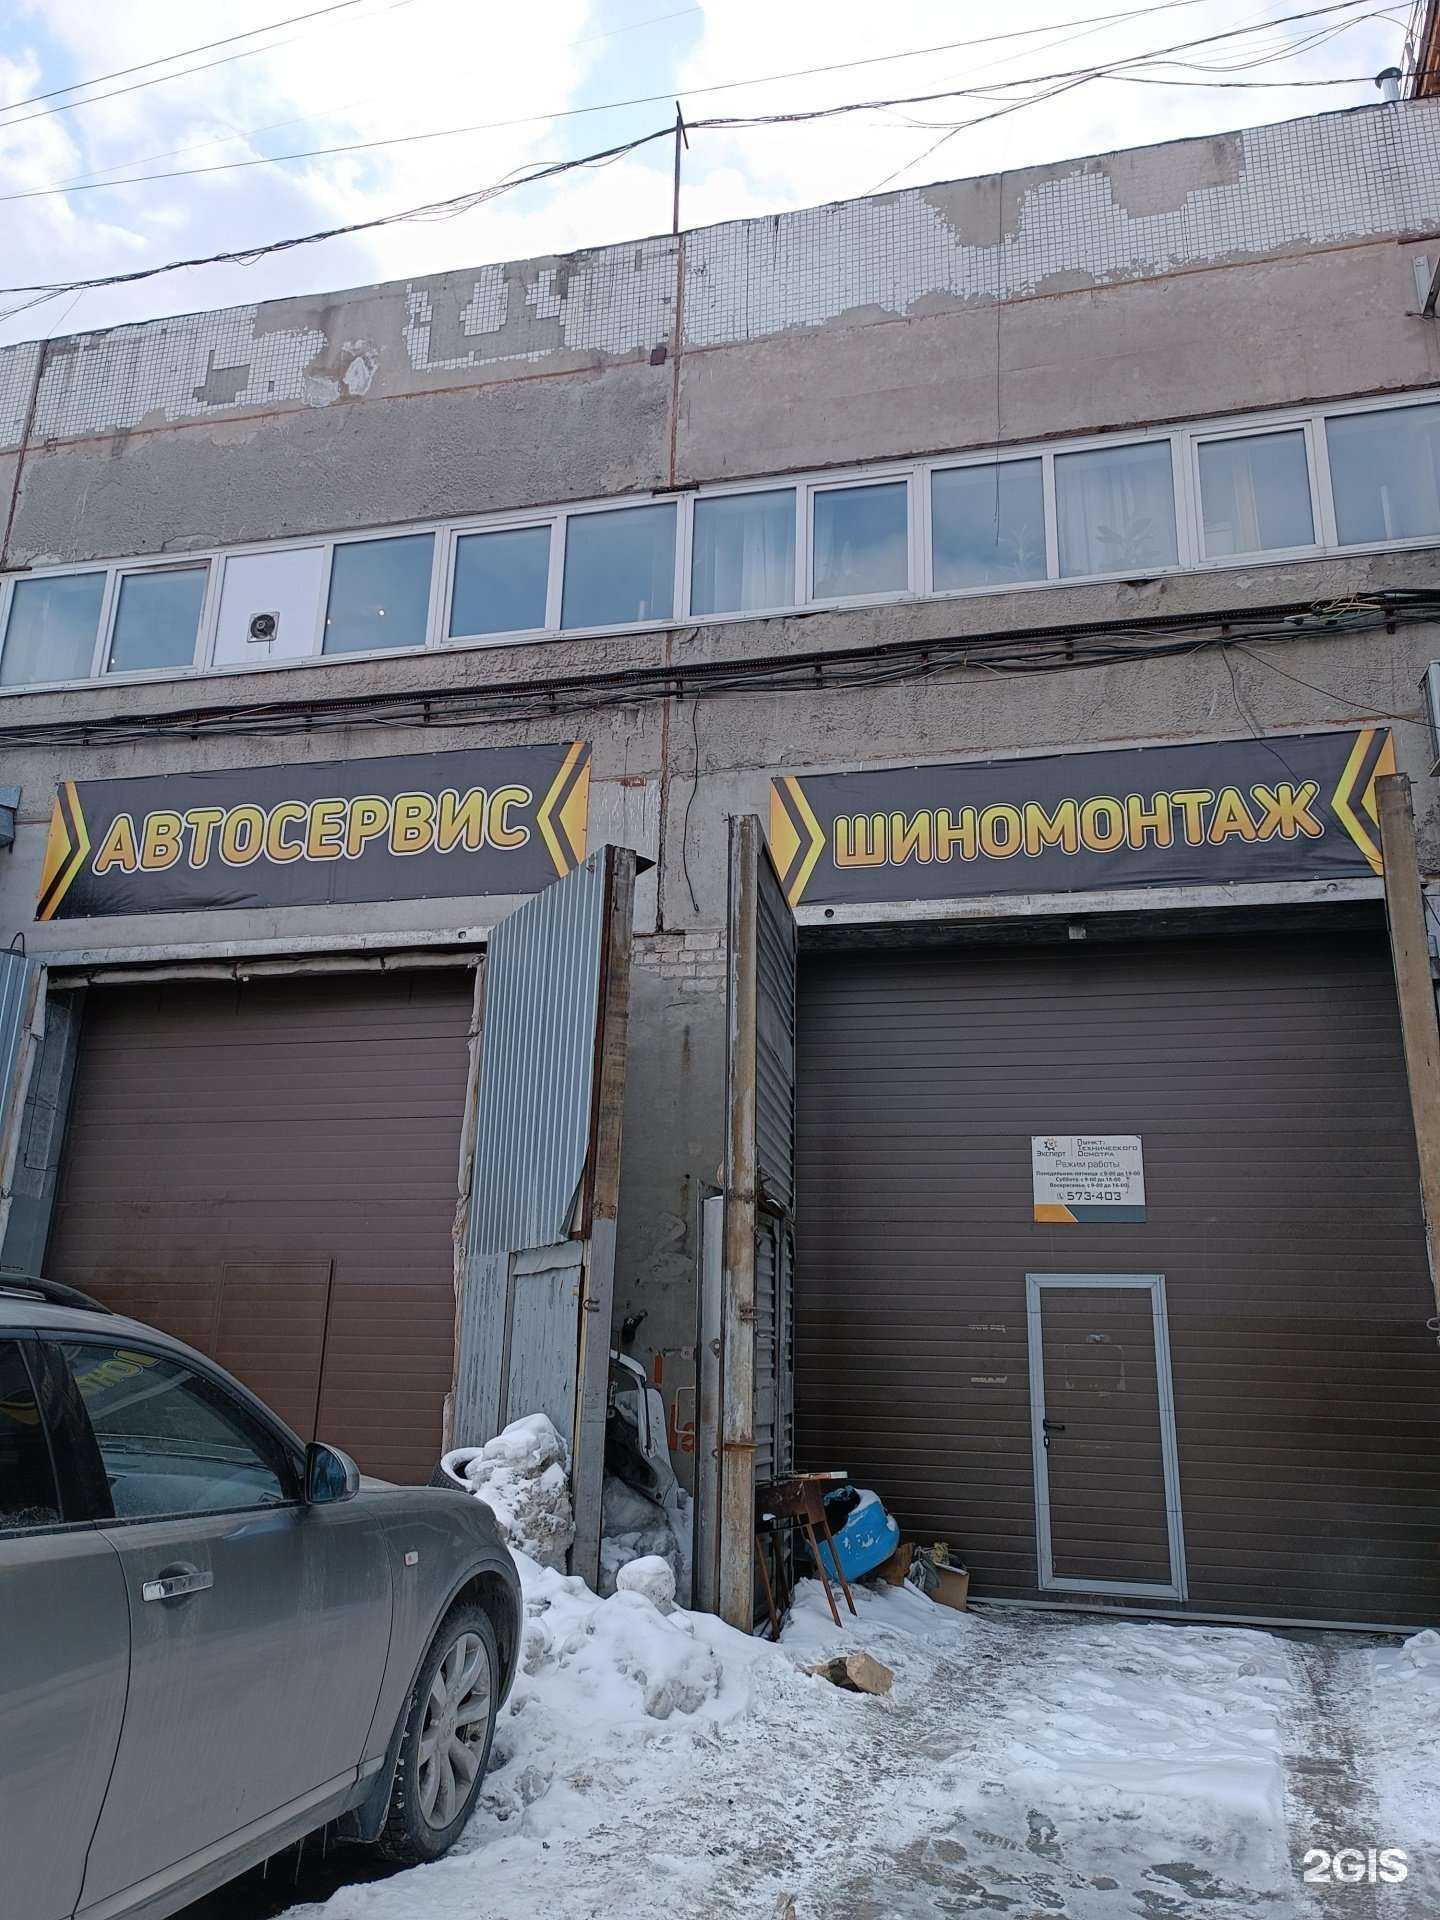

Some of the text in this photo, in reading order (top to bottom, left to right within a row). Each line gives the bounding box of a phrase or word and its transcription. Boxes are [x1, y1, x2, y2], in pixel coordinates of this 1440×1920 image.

[91, 784, 533, 875] АВТОСЕРВИС
[832, 780, 1325, 870] ШИНОМОНТАЖ
[1056, 1160, 1120, 1170] Режим работы
[1066, 1191, 1122, 1201] 573-403
